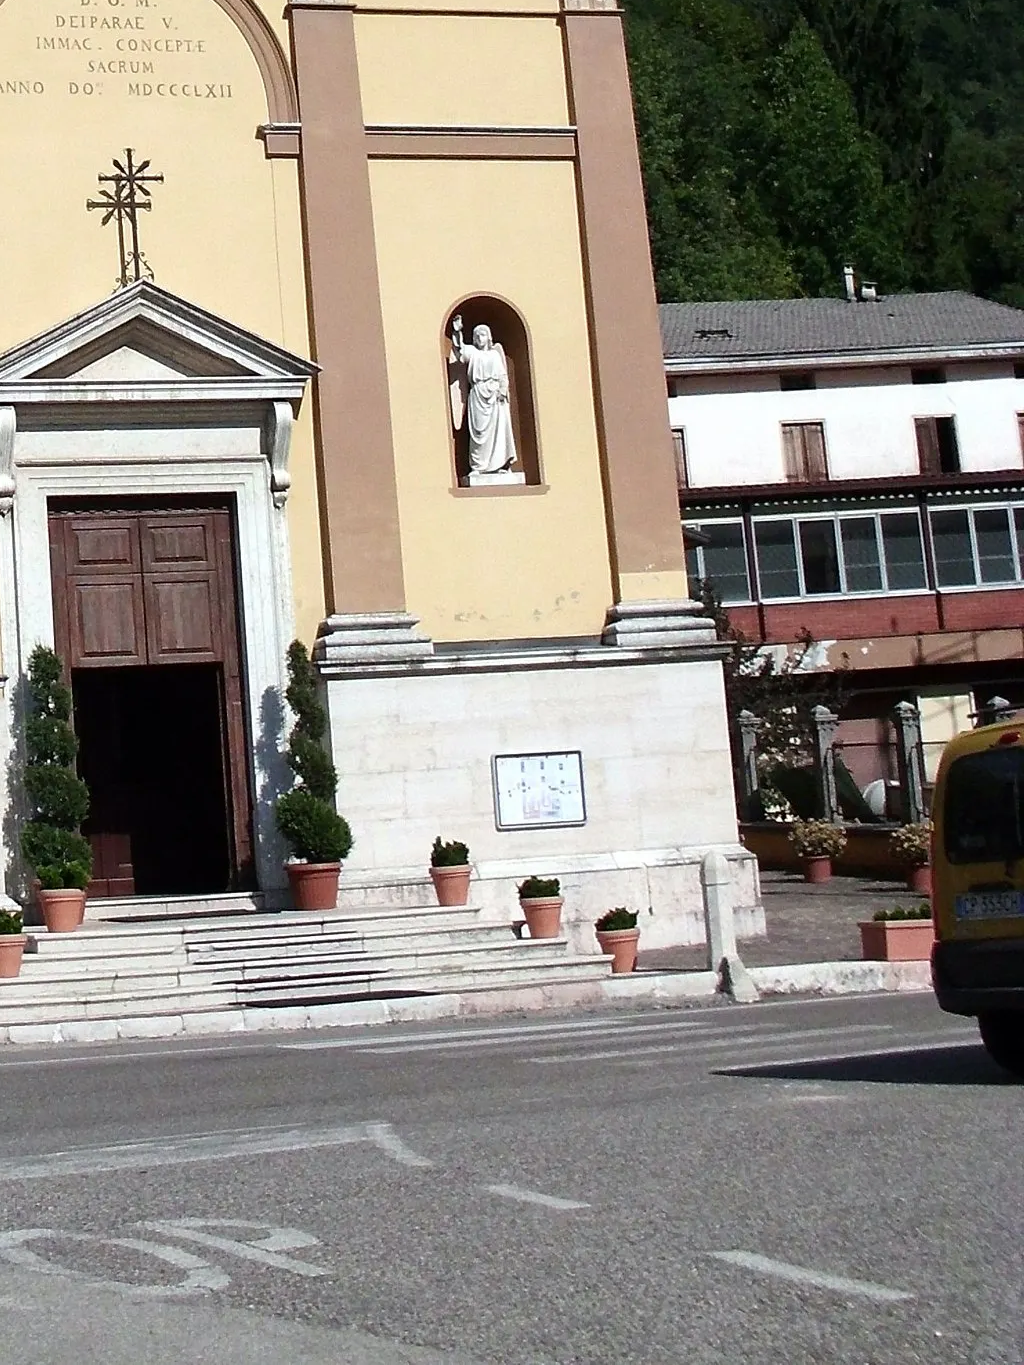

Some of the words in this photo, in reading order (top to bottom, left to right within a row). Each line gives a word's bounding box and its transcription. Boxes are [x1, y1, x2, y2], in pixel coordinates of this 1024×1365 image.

[55, 15, 145, 30] DEIPARAE
[161, 16, 178, 30] V.
[87, 60, 155, 74] SACRUM
[128, 82, 233, 98] MDCCCLXII
